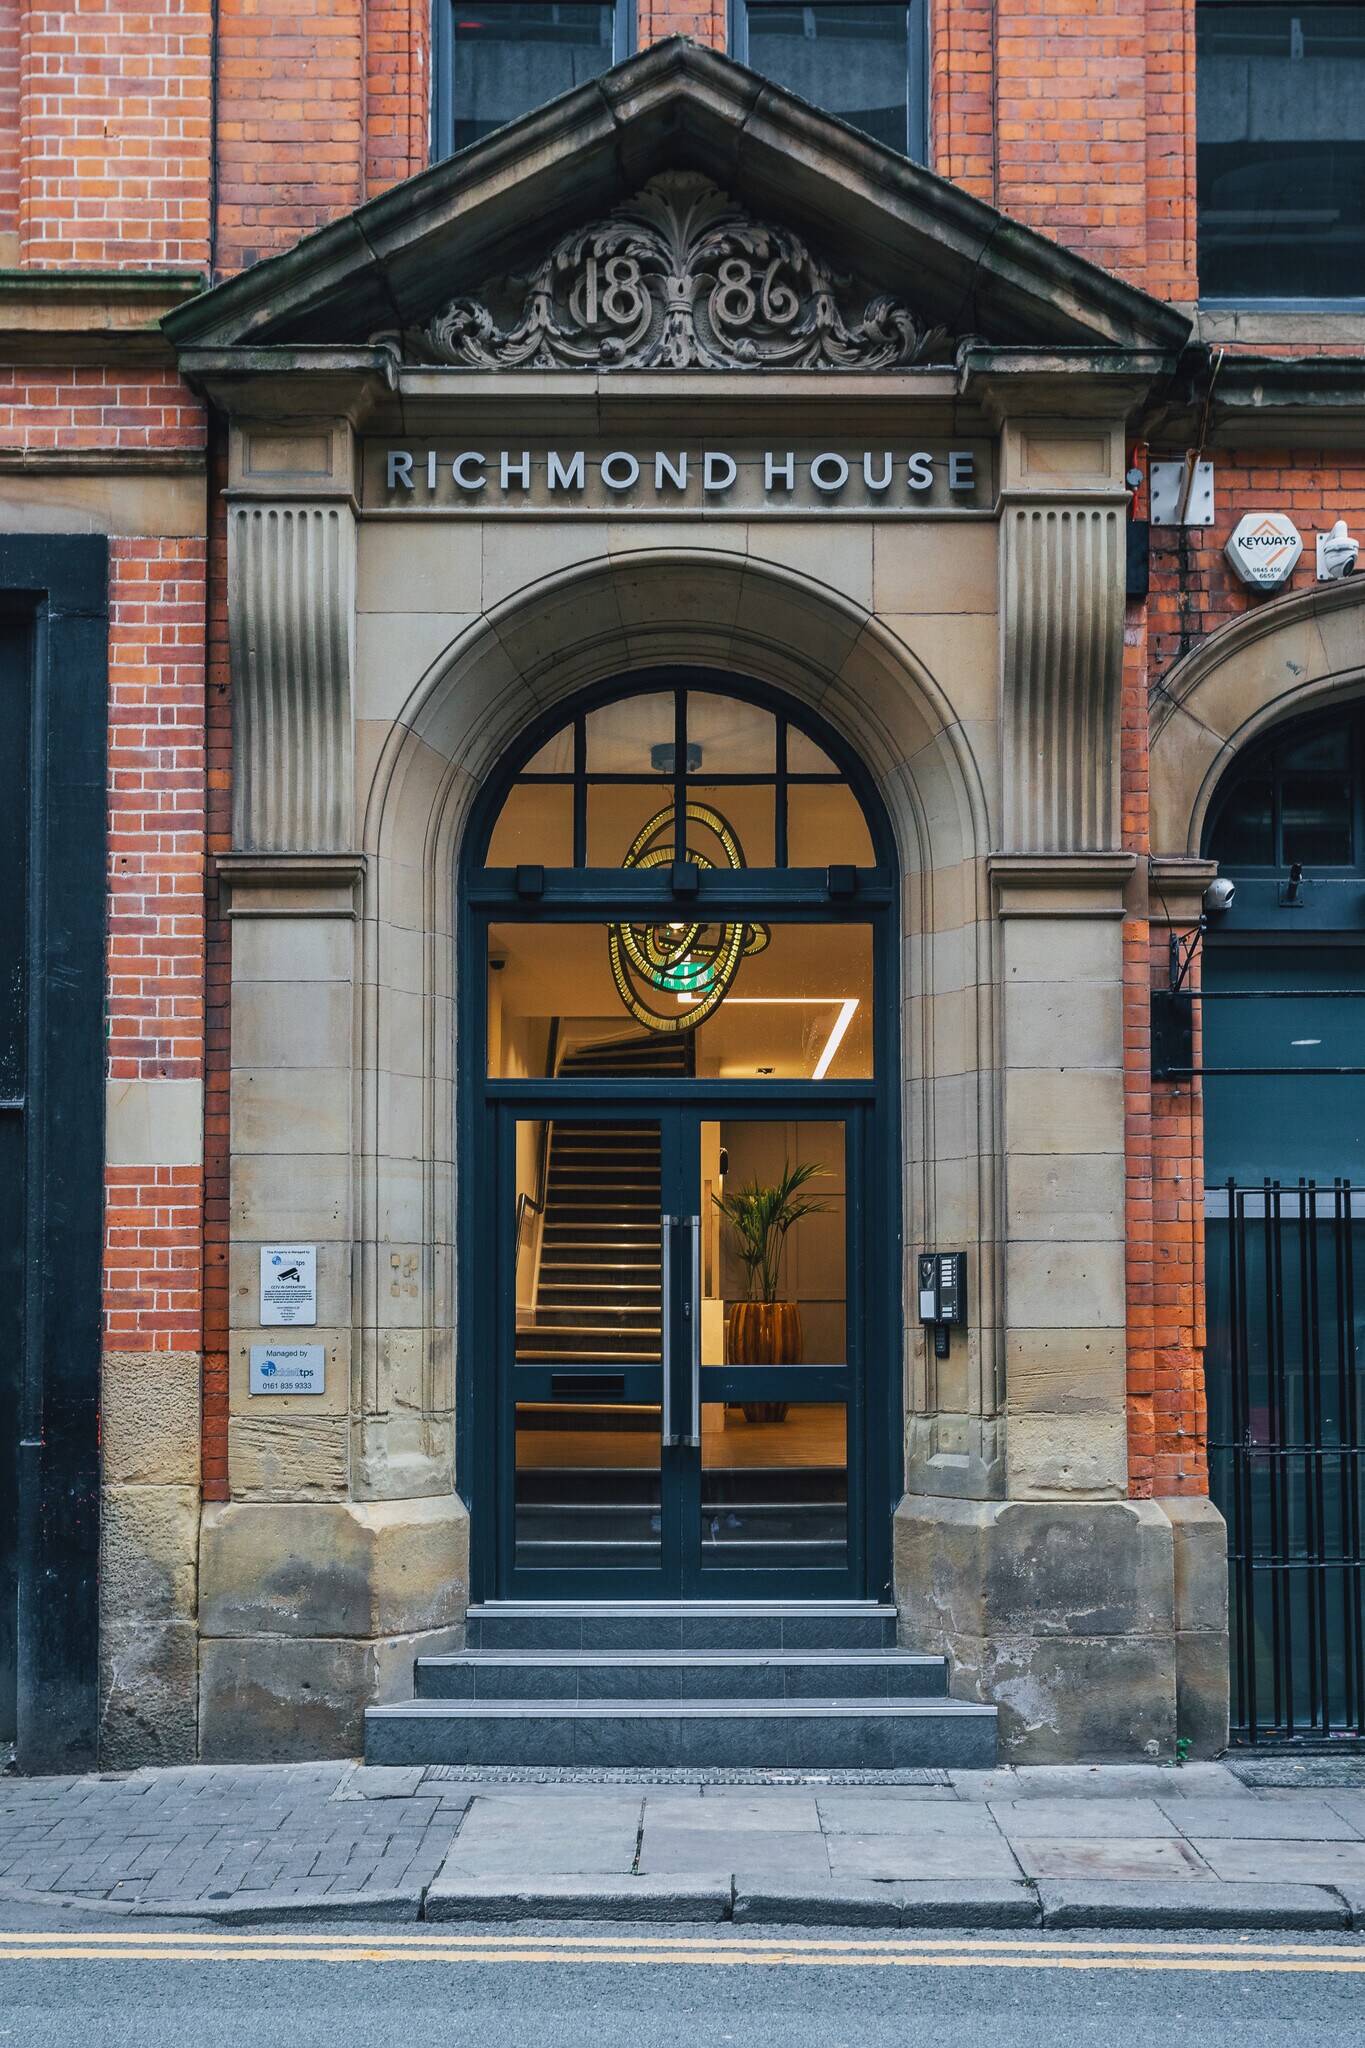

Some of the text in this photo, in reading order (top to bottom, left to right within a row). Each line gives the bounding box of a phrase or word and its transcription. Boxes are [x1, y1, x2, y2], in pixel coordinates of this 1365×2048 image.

[585, 256, 799, 325] 18 86
[387, 451, 975, 490] RICHMOND HOUSE
[1238, 536, 1296, 549] KEYWAYS
[266, 1350, 308, 1358] Managed by
